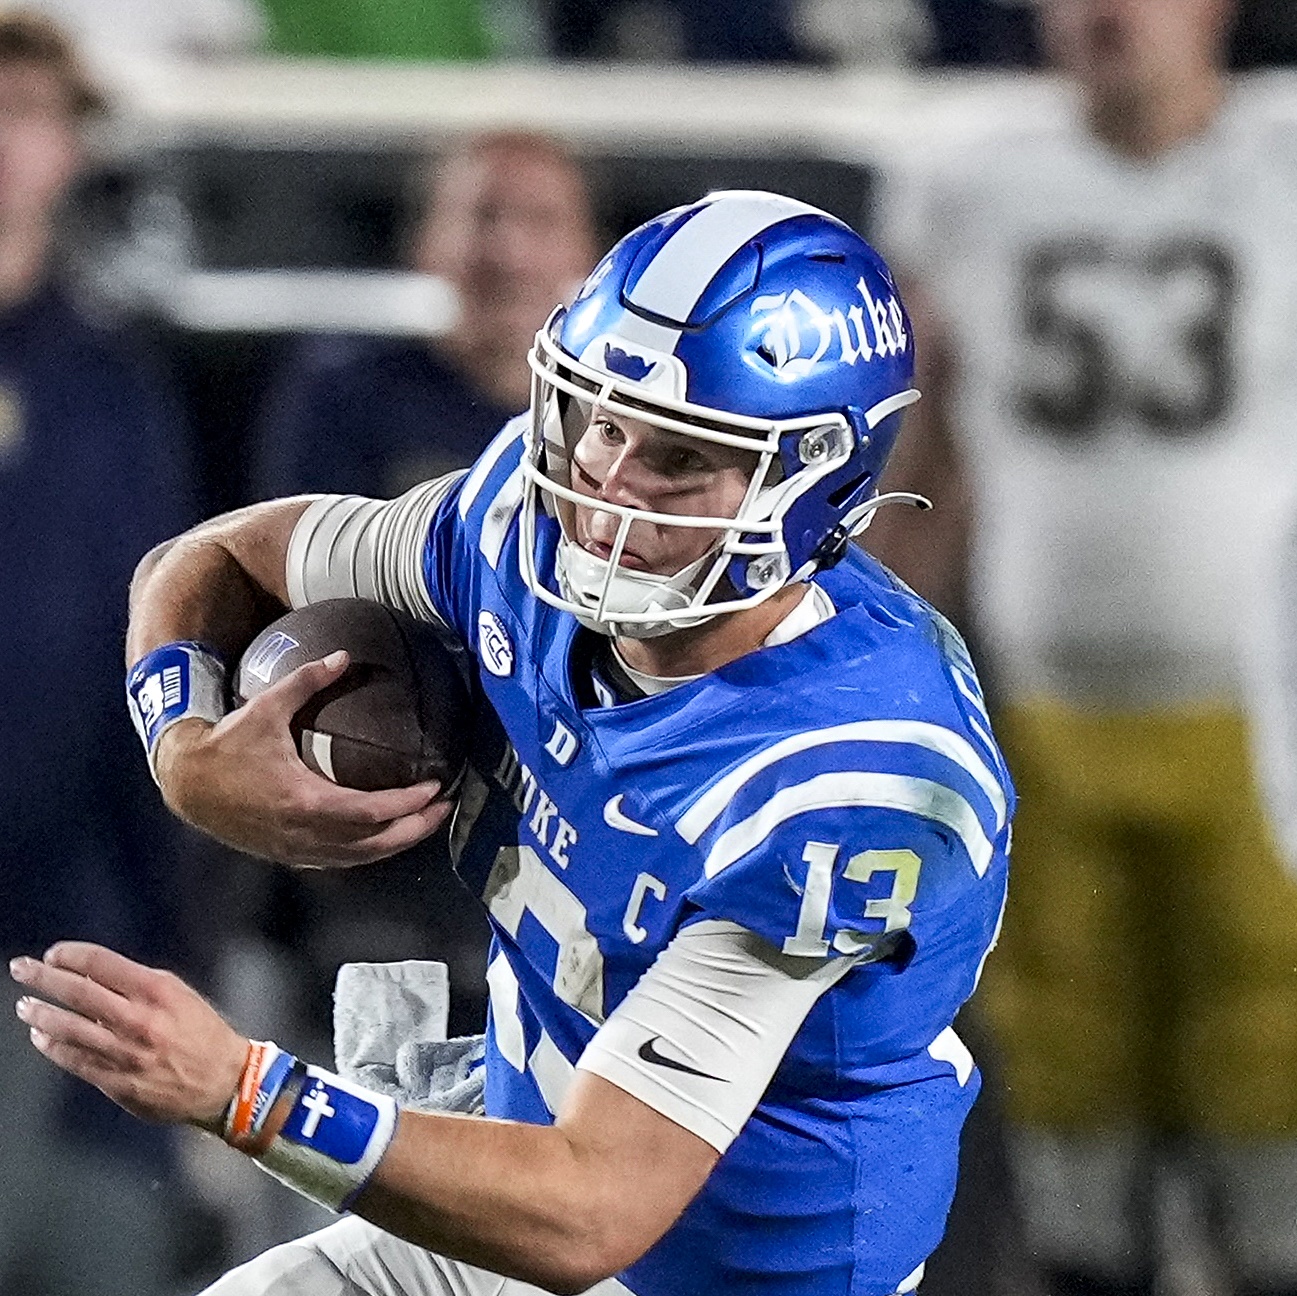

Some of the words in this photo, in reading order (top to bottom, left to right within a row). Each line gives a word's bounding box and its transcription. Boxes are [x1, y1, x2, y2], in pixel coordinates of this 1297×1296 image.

[745, 276, 907, 375] Duke
[1014, 232, 1237, 436] 53
[482, 623, 513, 668] ACC
[544, 719, 578, 767] D
[493, 741, 578, 870] DUKE
[623, 871, 667, 944] C
[781, 840, 923, 957] 13
